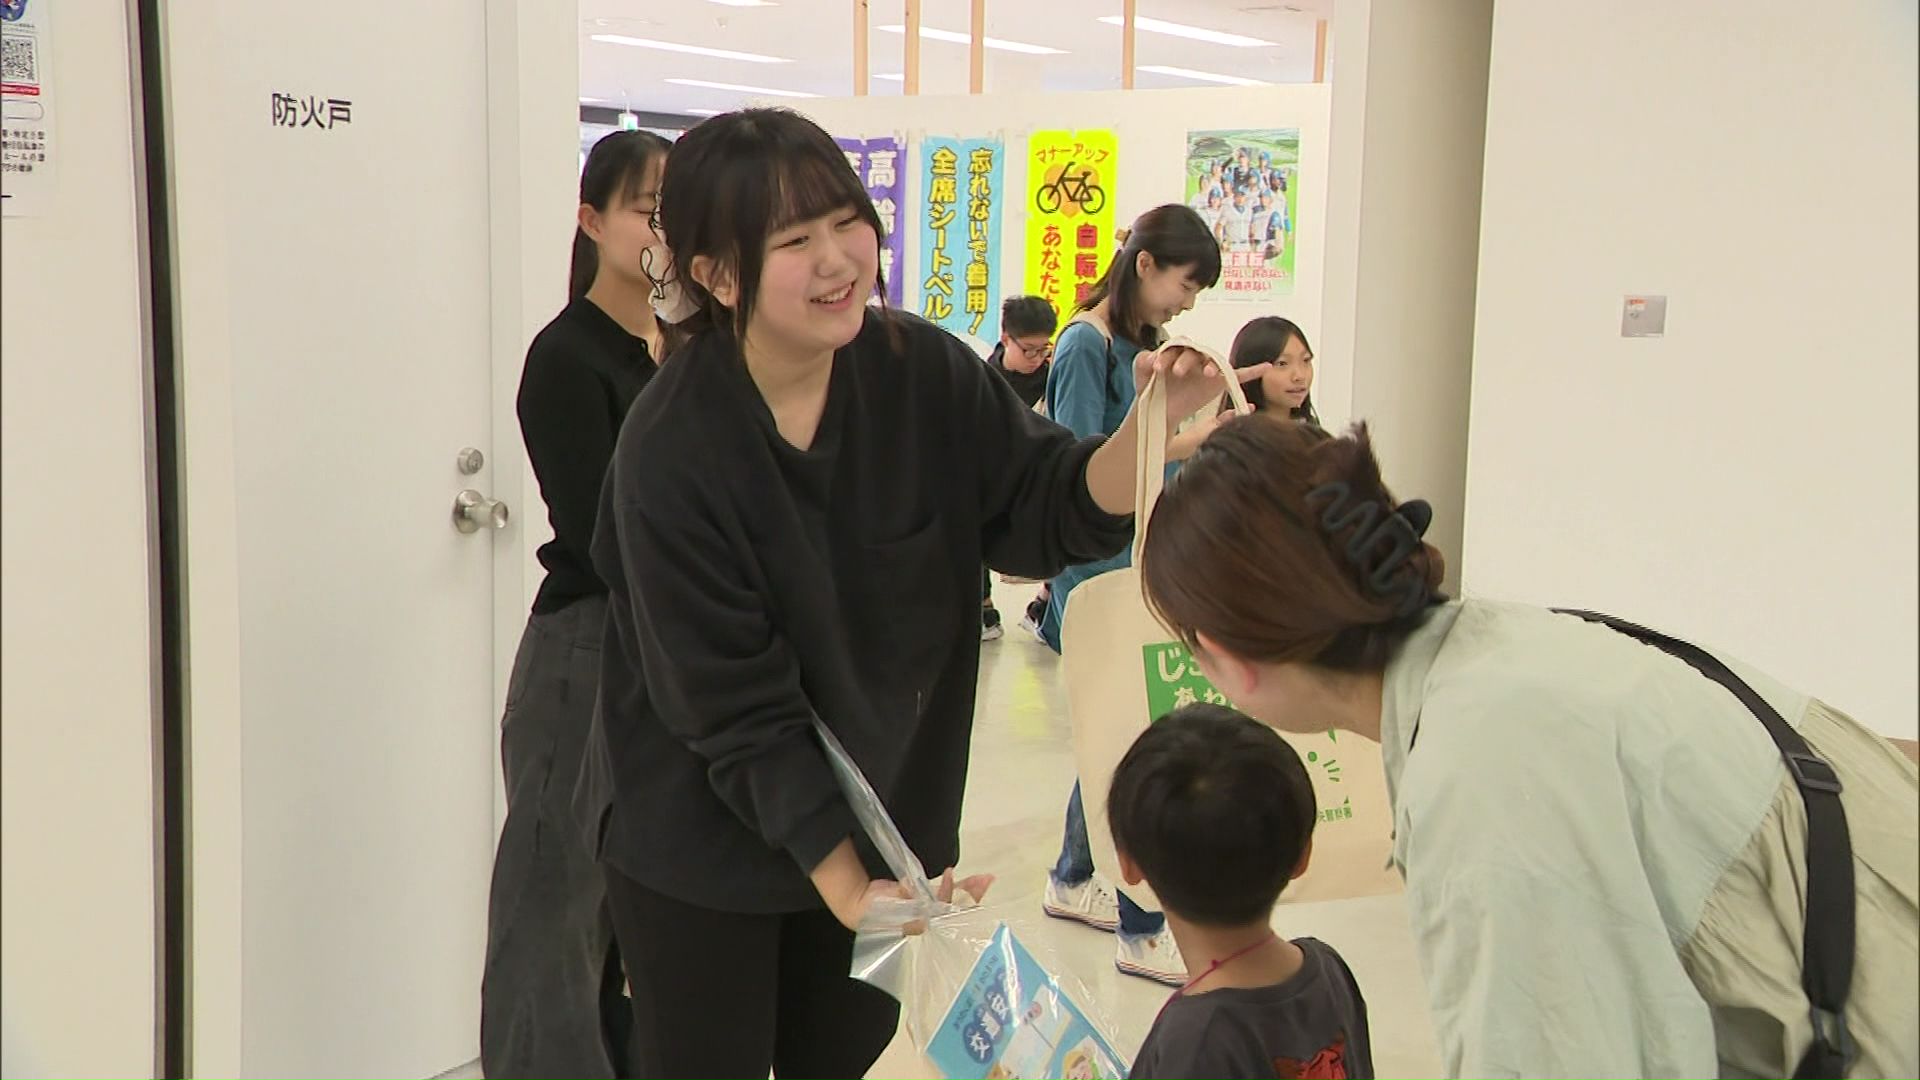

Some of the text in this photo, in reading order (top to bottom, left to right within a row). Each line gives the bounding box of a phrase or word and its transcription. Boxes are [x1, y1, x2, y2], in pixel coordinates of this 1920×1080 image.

[271, 92, 352, 129] 防火戸
[1036, 143, 1110, 163] マナーアップ
[923, 146, 957, 325] 全席シートベル
[965, 147, 993, 336] 忘れないで着用！
